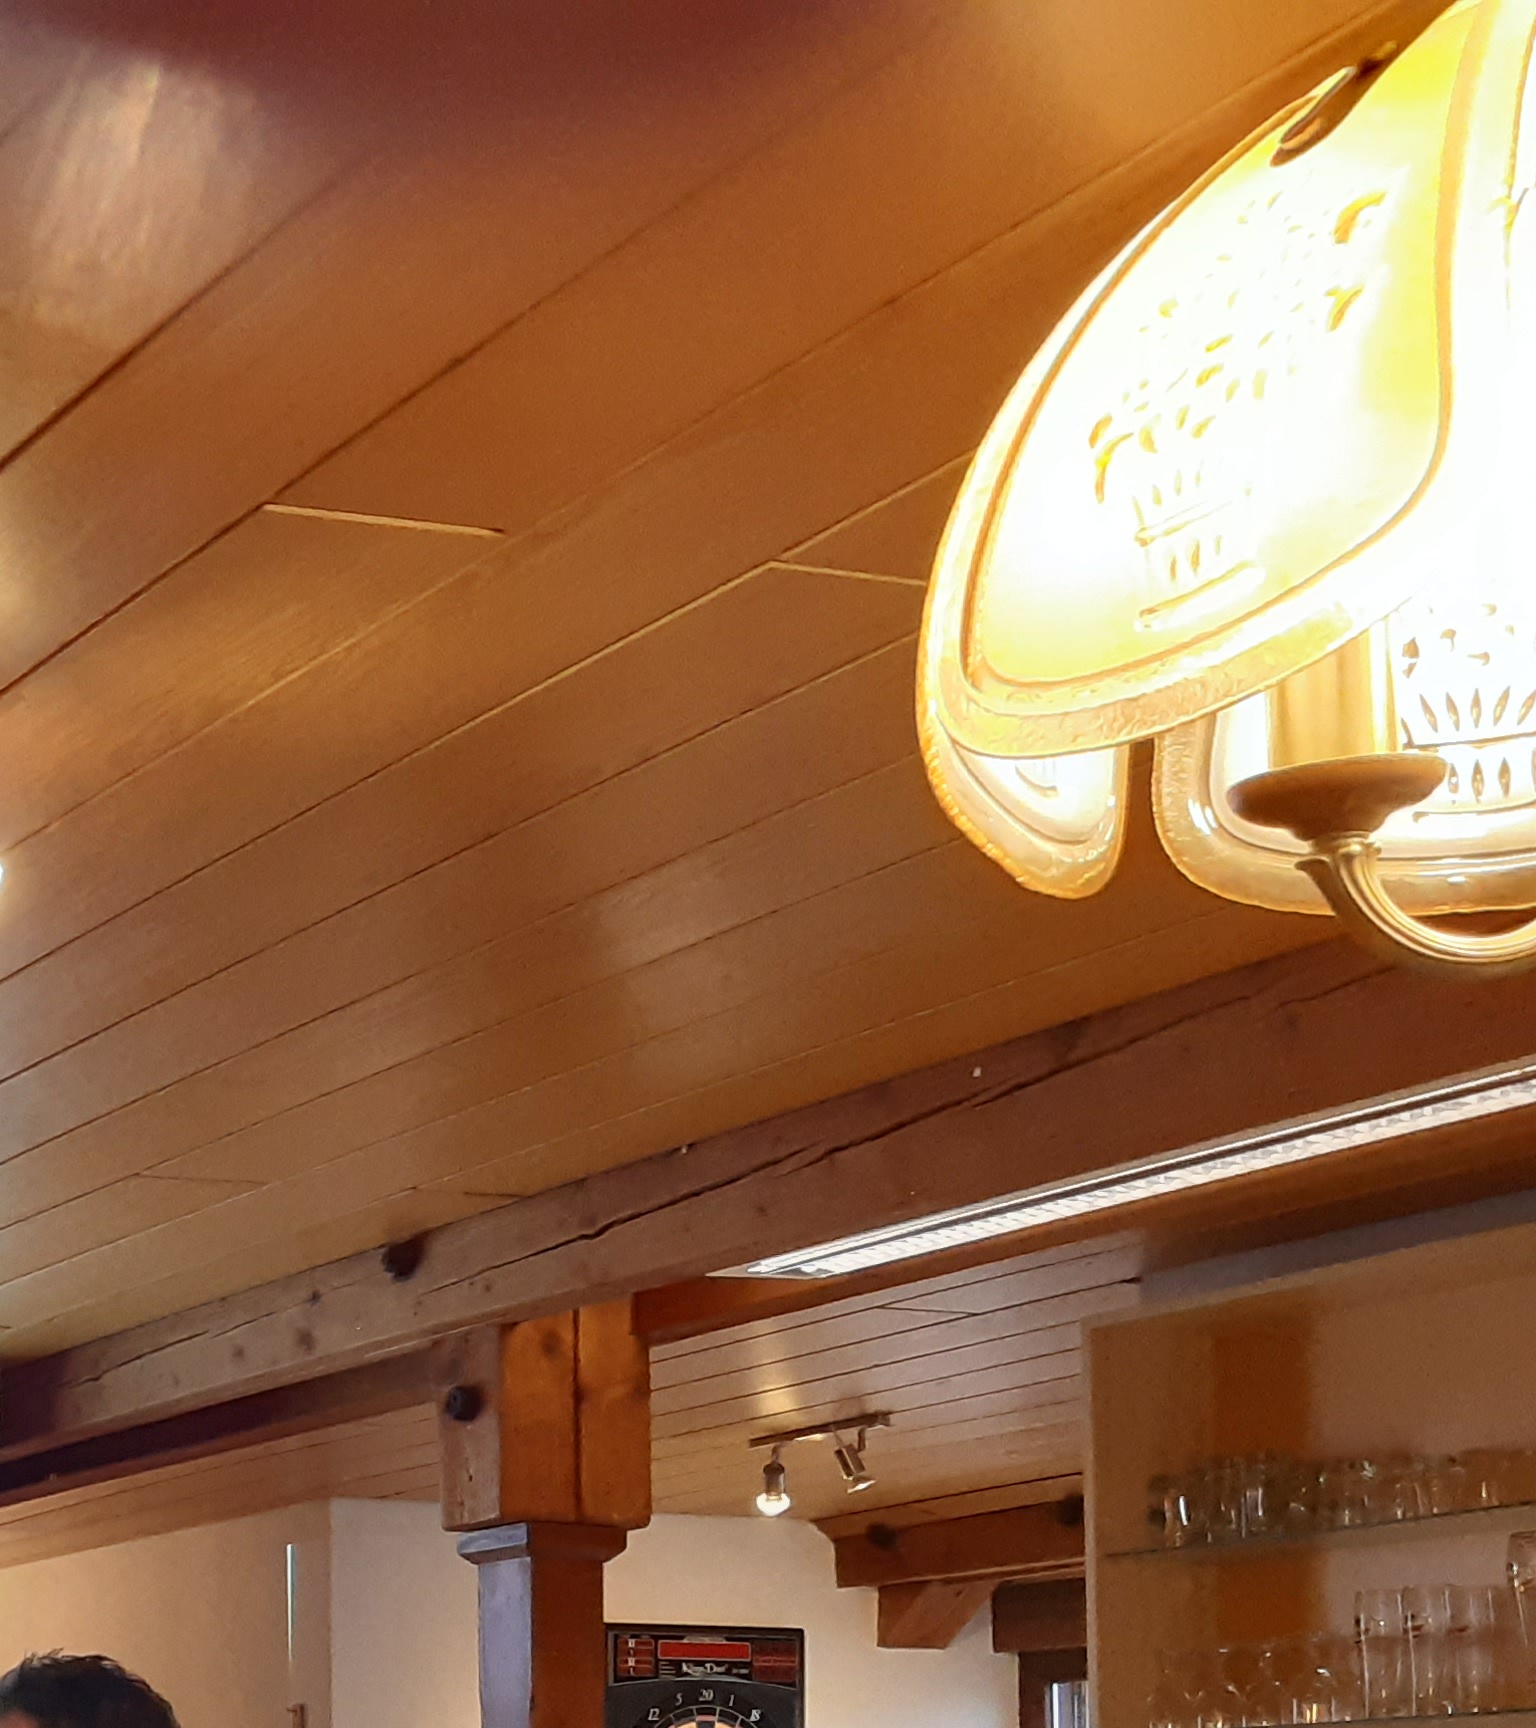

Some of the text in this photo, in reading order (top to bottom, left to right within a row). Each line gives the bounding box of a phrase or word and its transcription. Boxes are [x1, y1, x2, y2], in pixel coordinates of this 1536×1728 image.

[675, 1692, 683, 1706] 5
[697, 1688, 714, 1702] 20
[728, 1694, 735, 1707] 1
[647, 1707, 660, 1721] 12
[749, 1709, 762, 1722] 18
